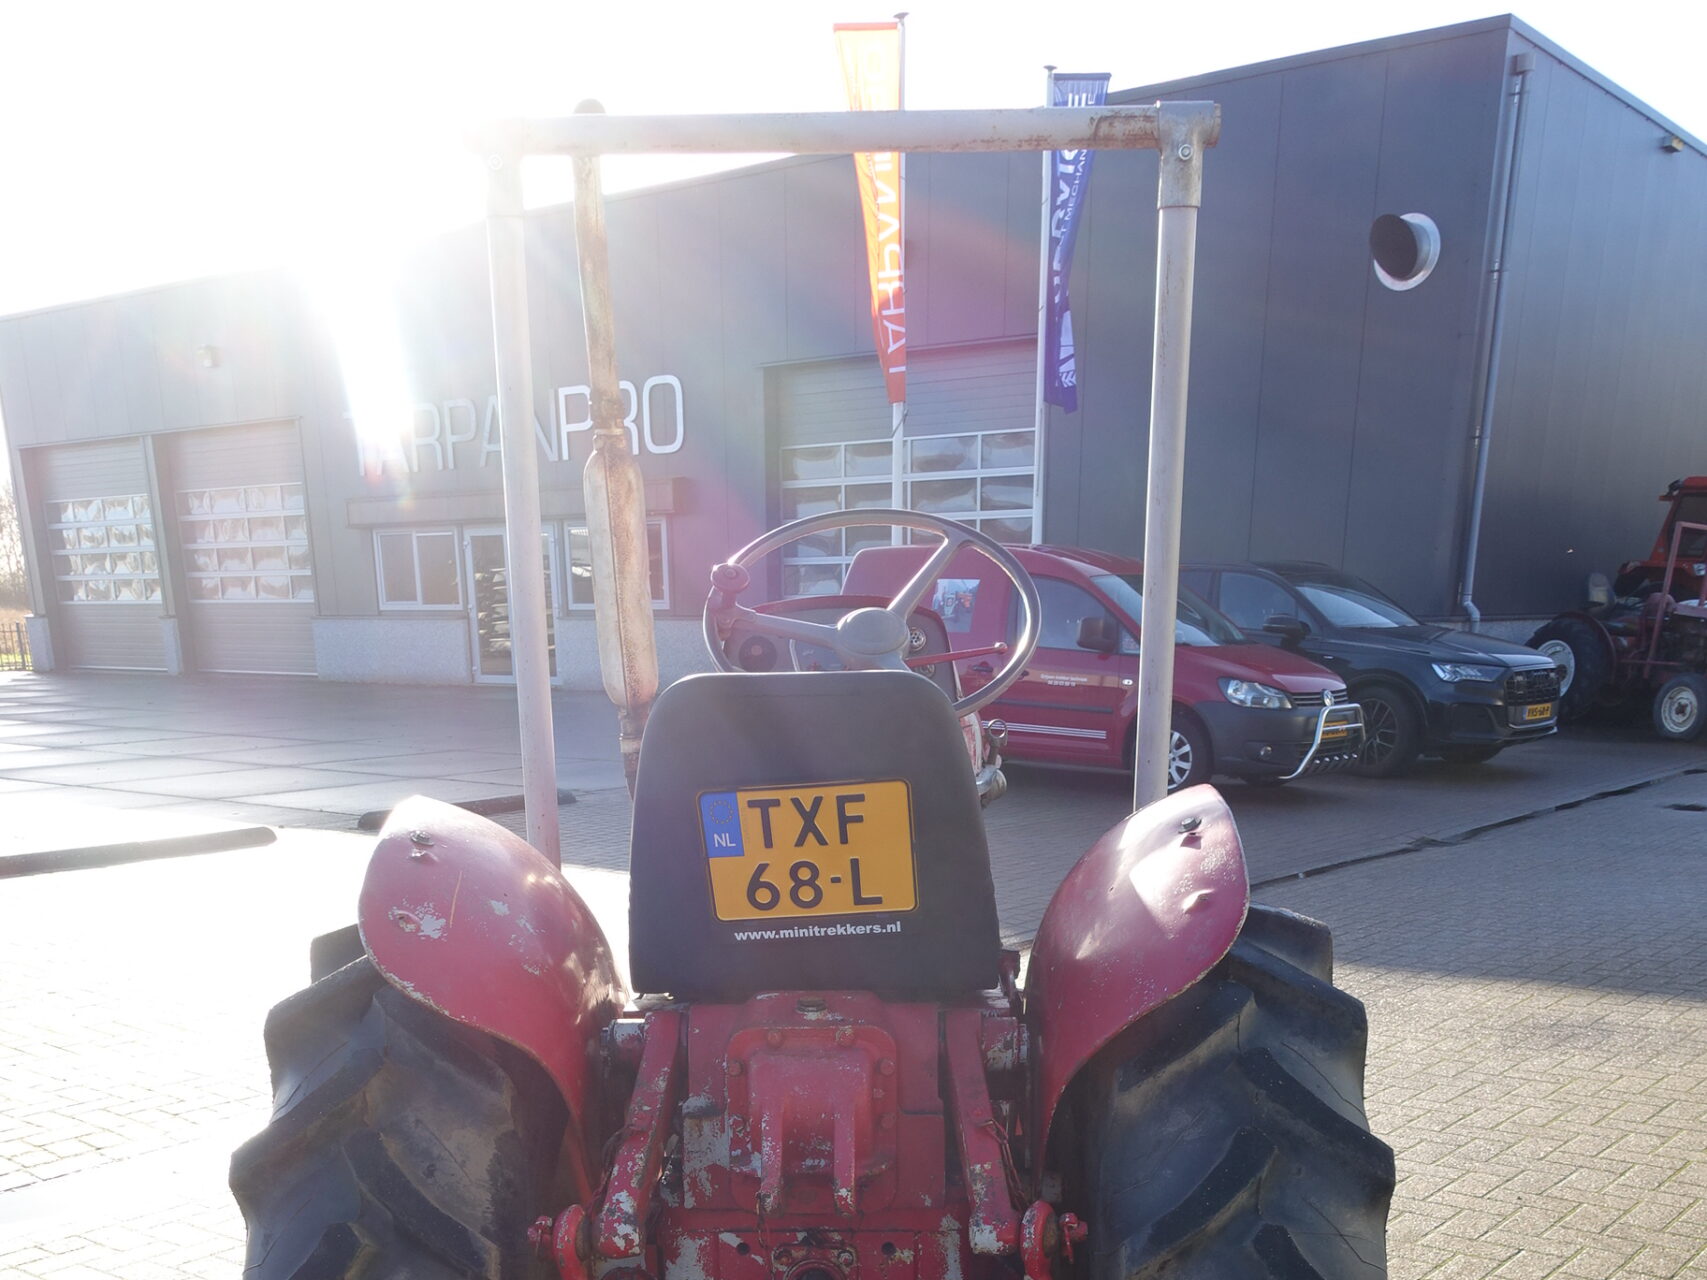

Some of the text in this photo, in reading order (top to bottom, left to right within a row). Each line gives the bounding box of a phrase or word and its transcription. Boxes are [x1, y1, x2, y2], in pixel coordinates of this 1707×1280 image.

[746, 793, 866, 849] TXF
[713, 833, 737, 848] NL
[746, 856, 883, 911] 68-L
[733, 920, 902, 941] www.minitrekkers.nl
